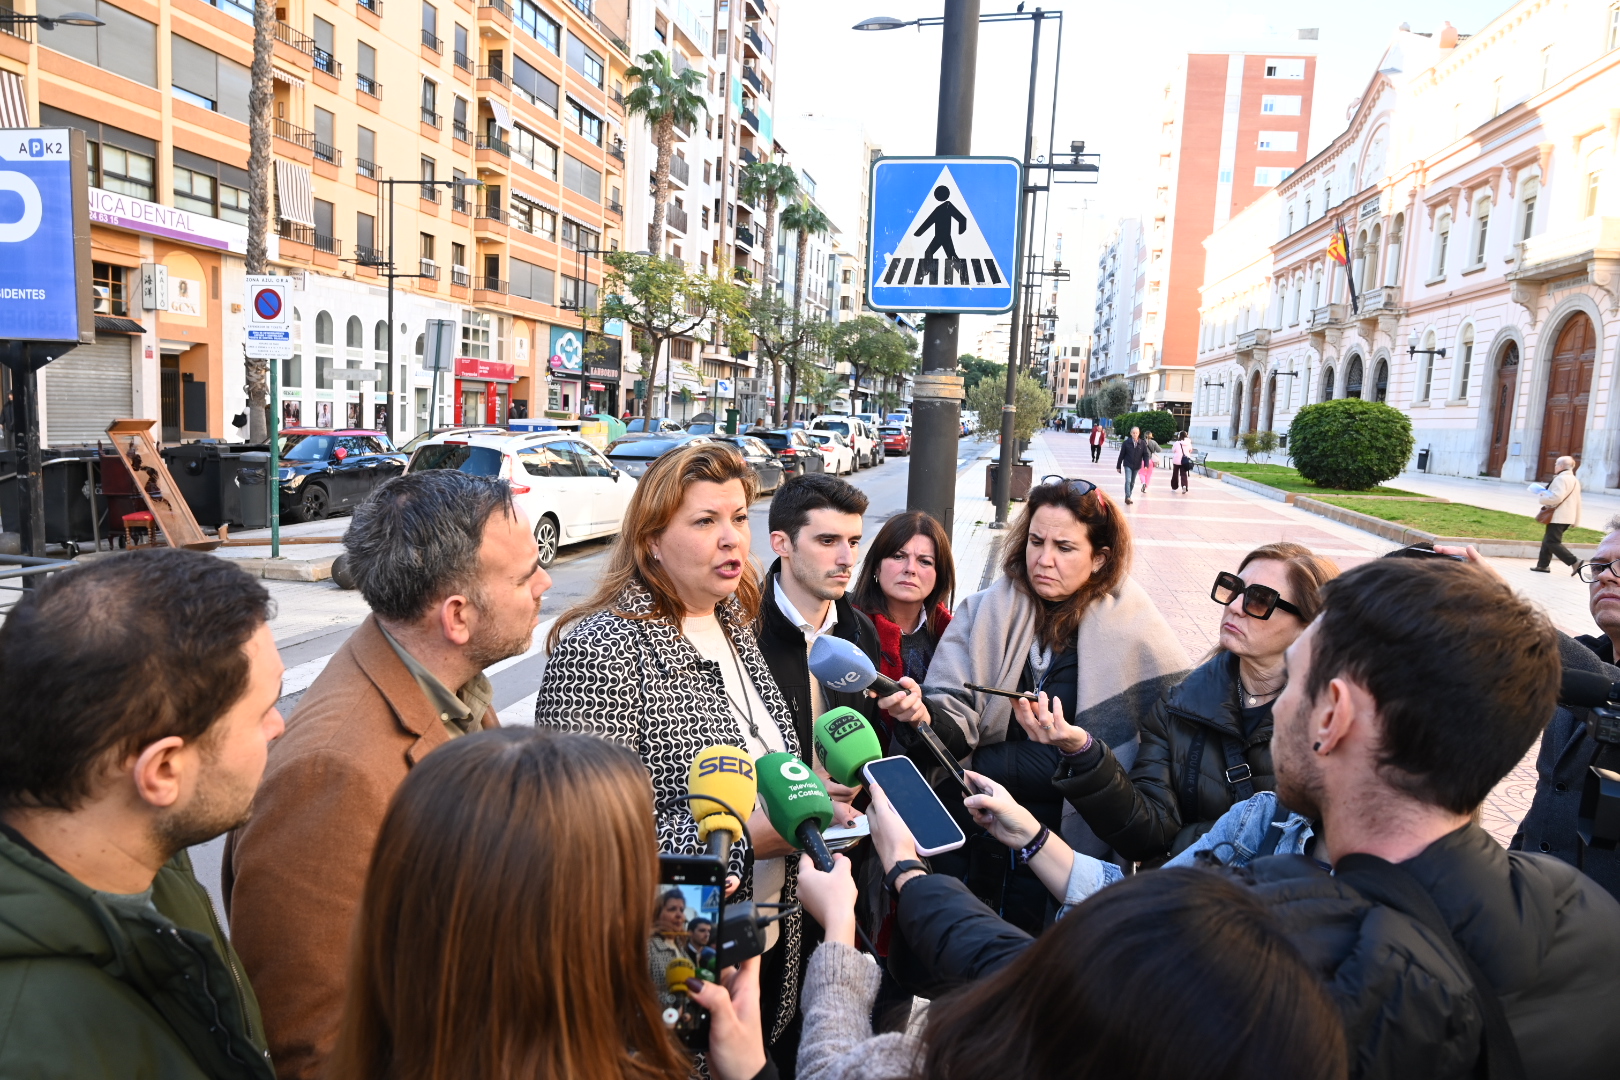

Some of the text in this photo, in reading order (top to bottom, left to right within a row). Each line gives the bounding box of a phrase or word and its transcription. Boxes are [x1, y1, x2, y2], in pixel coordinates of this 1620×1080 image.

[99, 213, 109, 222] 63
[110, 216, 119, 225] 15
[131, 201, 195, 231] DENTAL
[0, 288, 46, 300] IDENTES
[826, 671, 861, 689] tve
[837, 722, 859, 735] CERO
[698, 755, 754, 781] SER
[788, 792, 798, 801] de
